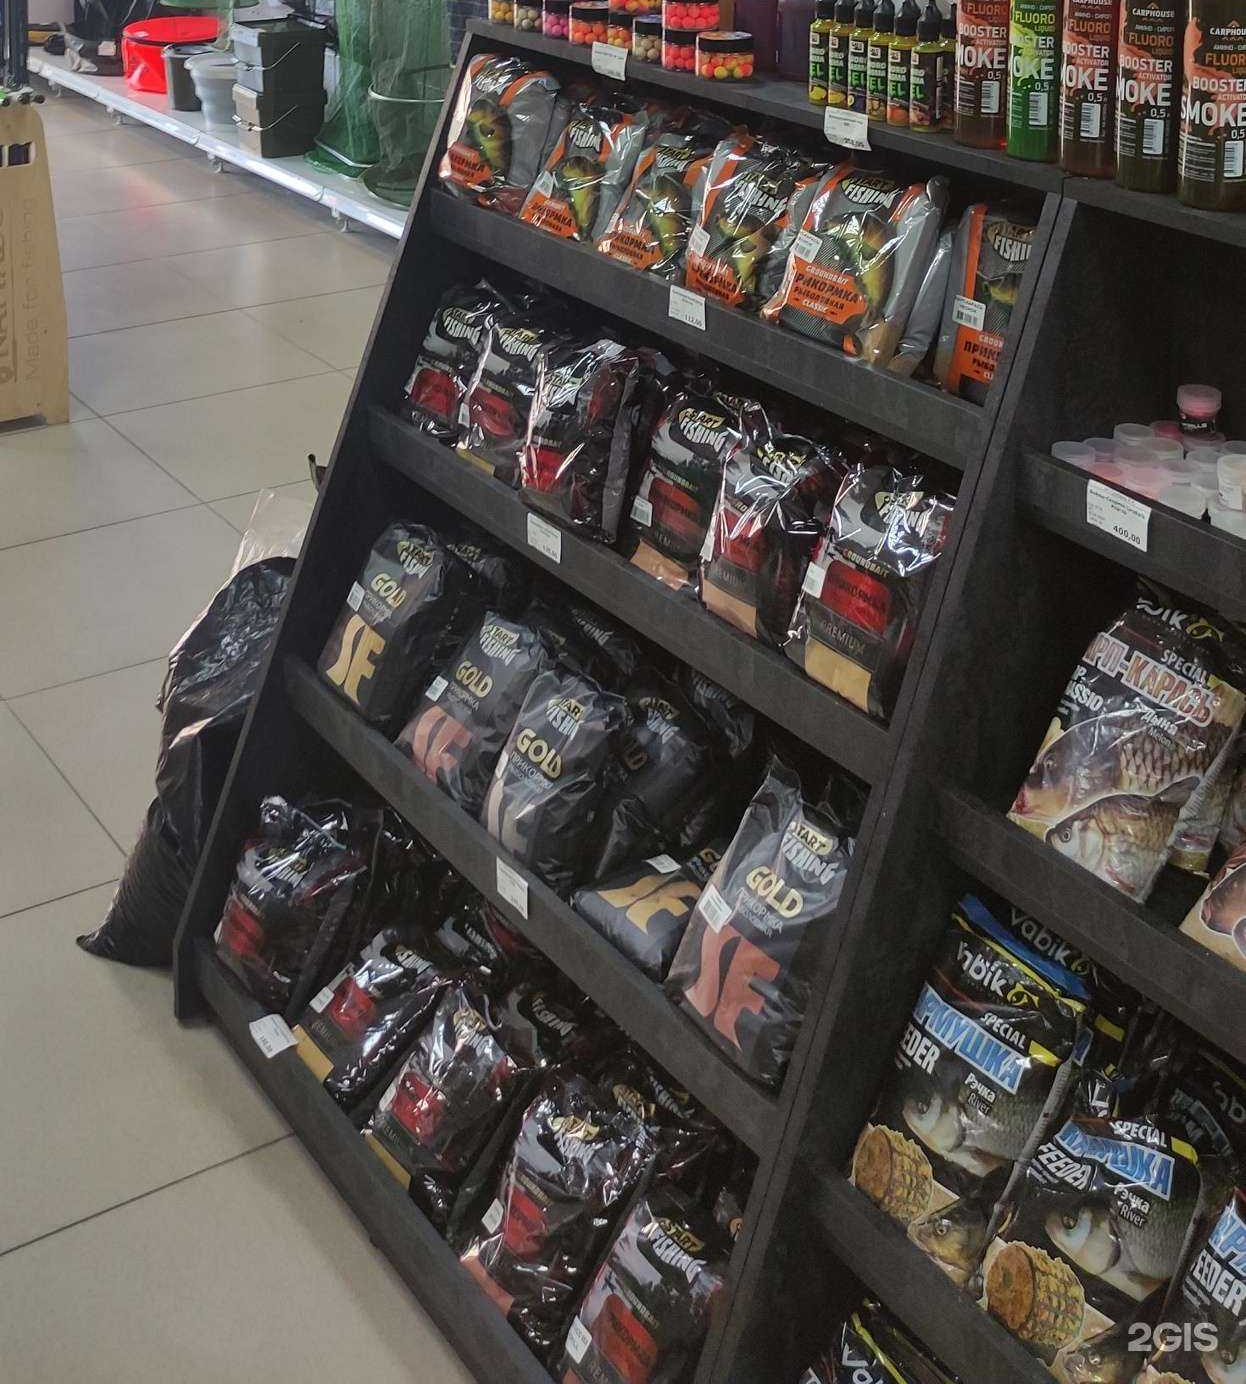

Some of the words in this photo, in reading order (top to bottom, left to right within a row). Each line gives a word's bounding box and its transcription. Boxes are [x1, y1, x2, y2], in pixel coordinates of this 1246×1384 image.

[1015, 12, 1055, 24] FLUORO
[1070, 19, 1110, 34] FLUORO
[1132, 7, 1175, 18] CARPHOUSE
[959, 23, 1007, 38] BOOSTER
[1129, 32, 1174, 47] FLUORO
[1119, 55, 1173, 73] BOOSTER
[1181, 95, 1246, 127] SMOKE
[993, 237, 1032, 262] FISHI
[795, 274, 858, 302] РИКОРМКА
[680, 420, 728, 450] FISHING
[1113, 525, 1141, 545] 400,00
[370, 573, 408, 608] GOLD
[455, 661, 494, 698] GOLD
[1084, 632, 1213, 728] РП-КАРАСЬ
[1160, 649, 1208, 686] SPECIAL
[516, 728, 563, 780] GOLD
[788, 820, 835, 854] START
[746, 864, 804, 918] GOLD
[1011, 907, 1072, 966] vabik
[980, 1012, 1026, 1050] SPECIAL
[901, 1023, 941, 1075] EDER
[968, 1092, 993, 1115] River
[1110, 1120, 1168, 1148] SPECIAL
[1037, 1143, 1092, 1190] FEEDER
[1120, 1204, 1147, 1227] River
[660, 1219, 703, 1253] START
